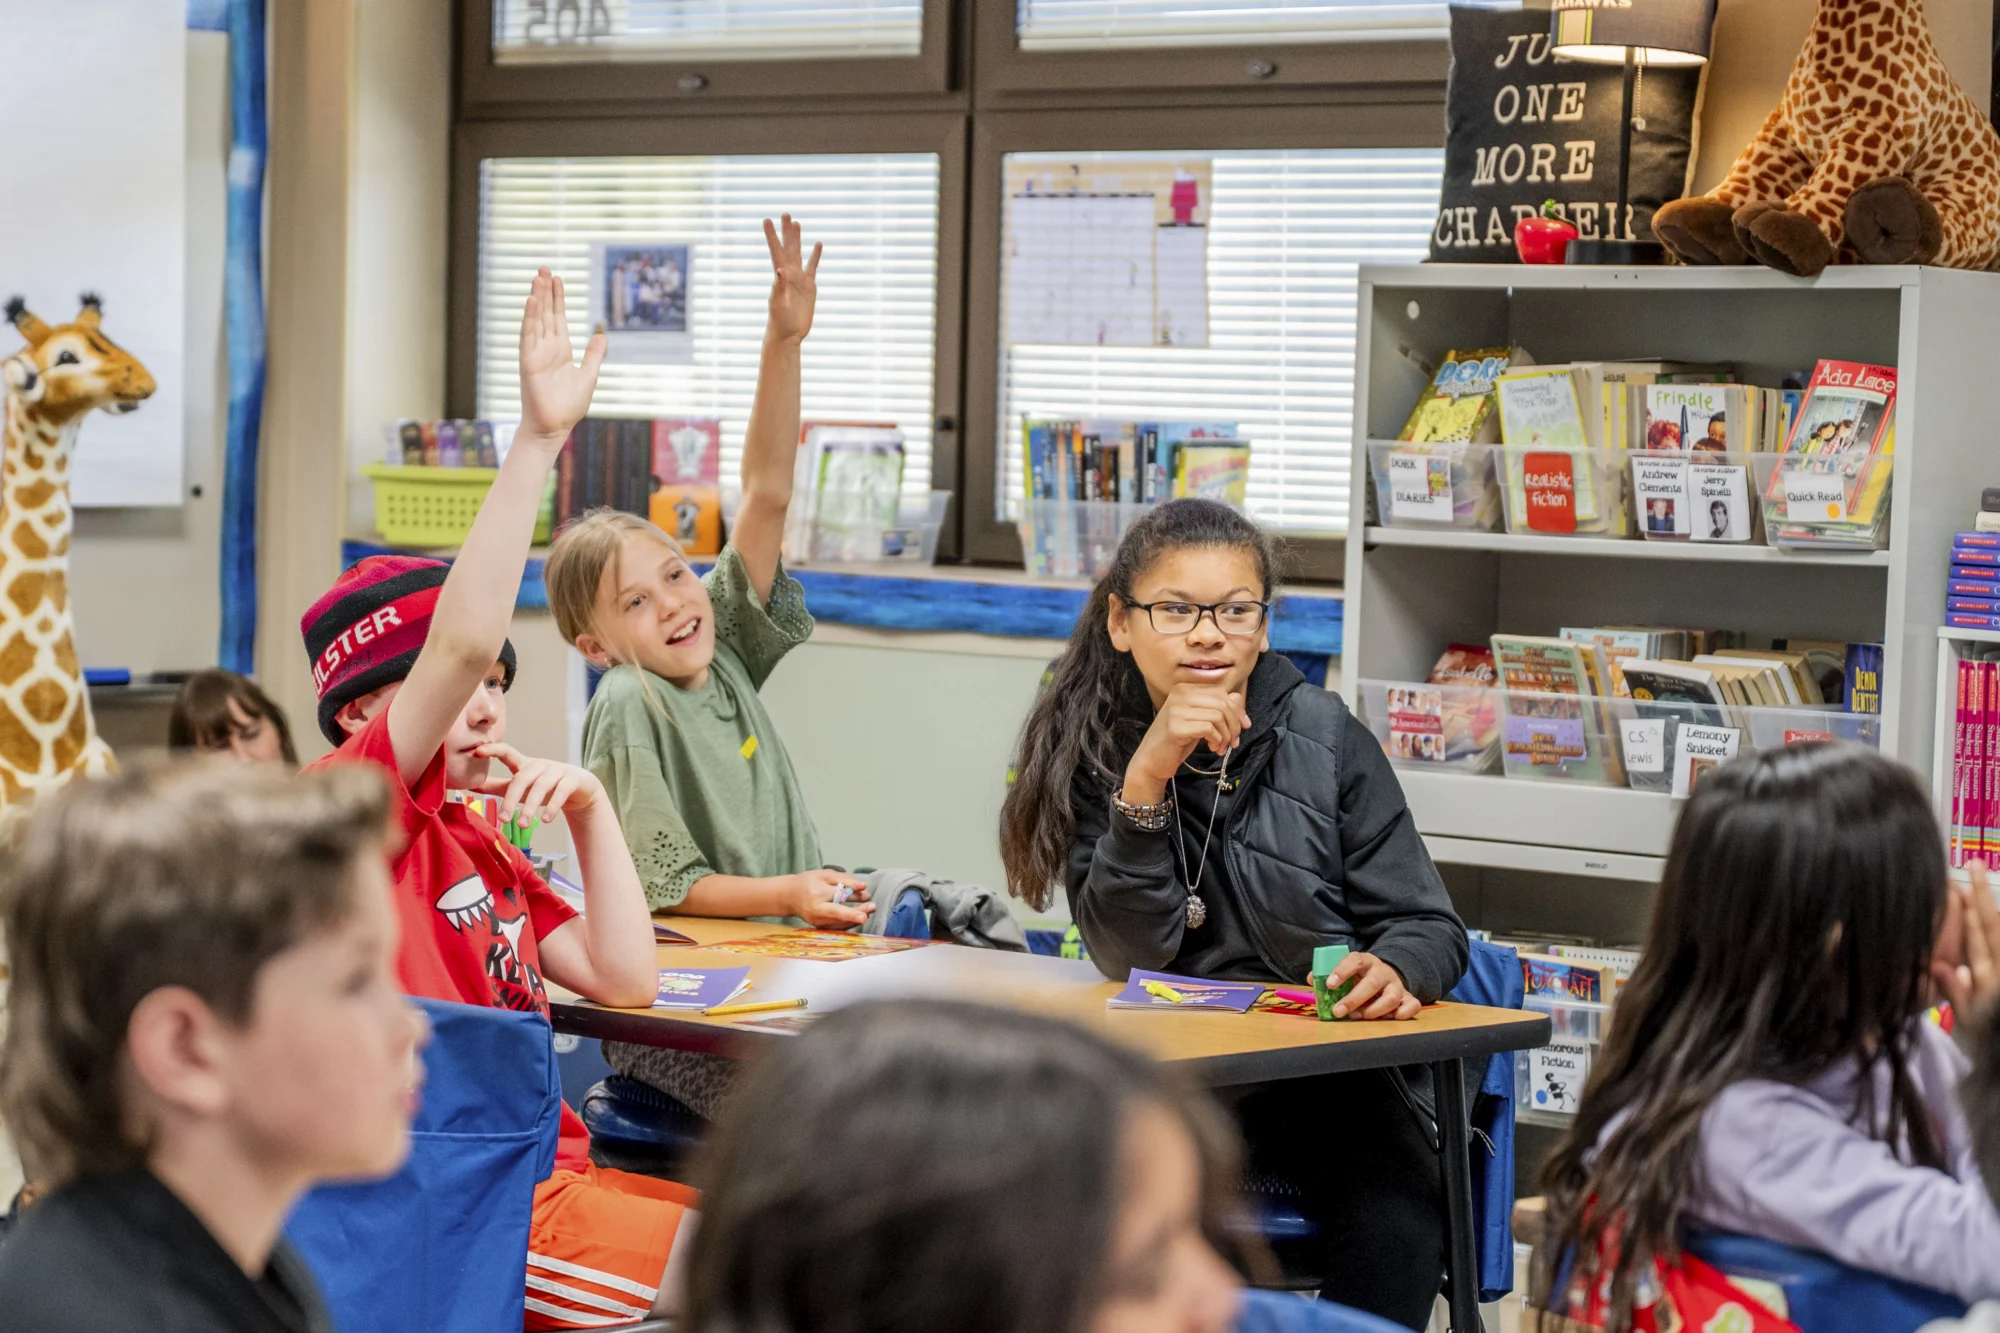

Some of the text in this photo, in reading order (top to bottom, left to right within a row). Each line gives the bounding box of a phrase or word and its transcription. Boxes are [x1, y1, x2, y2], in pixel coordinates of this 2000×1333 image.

[1494, 82, 1587, 124] ONE
[1471, 140, 1596, 186] MORE
[1816, 362, 1896, 393] Ada Lace
[1656, 390, 1714, 411] Frindle
[1391, 457, 1416, 469] DORK
[1641, 469, 1679, 480] Andrew
[1703, 476, 1727, 487] Jerry
[1639, 482, 1682, 494] Clements
[1701, 487, 1732, 498] Spinelli
[1396, 491, 1435, 504] DIARIES
[1787, 491, 1842, 502] Quick Read
[1855, 665, 1877, 691] DEMON
[1851, 687, 1879, 713] DENTIST
[1628, 731, 1648, 744] C.S.
[1686, 727, 1731, 743] Lemony
[1686, 742, 1728, 756] Snicket
[1627, 752, 1653, 764] Lewis
[1953, 722, 1964, 797] Student Thesaurus
[1964, 723, 1975, 799] Student Thesaurus
[1972, 724, 1983, 799] Student Thesaurus
[1985, 724, 1995, 800] Student Thesaurus
[1541, 1056, 1575, 1069] Fiction
